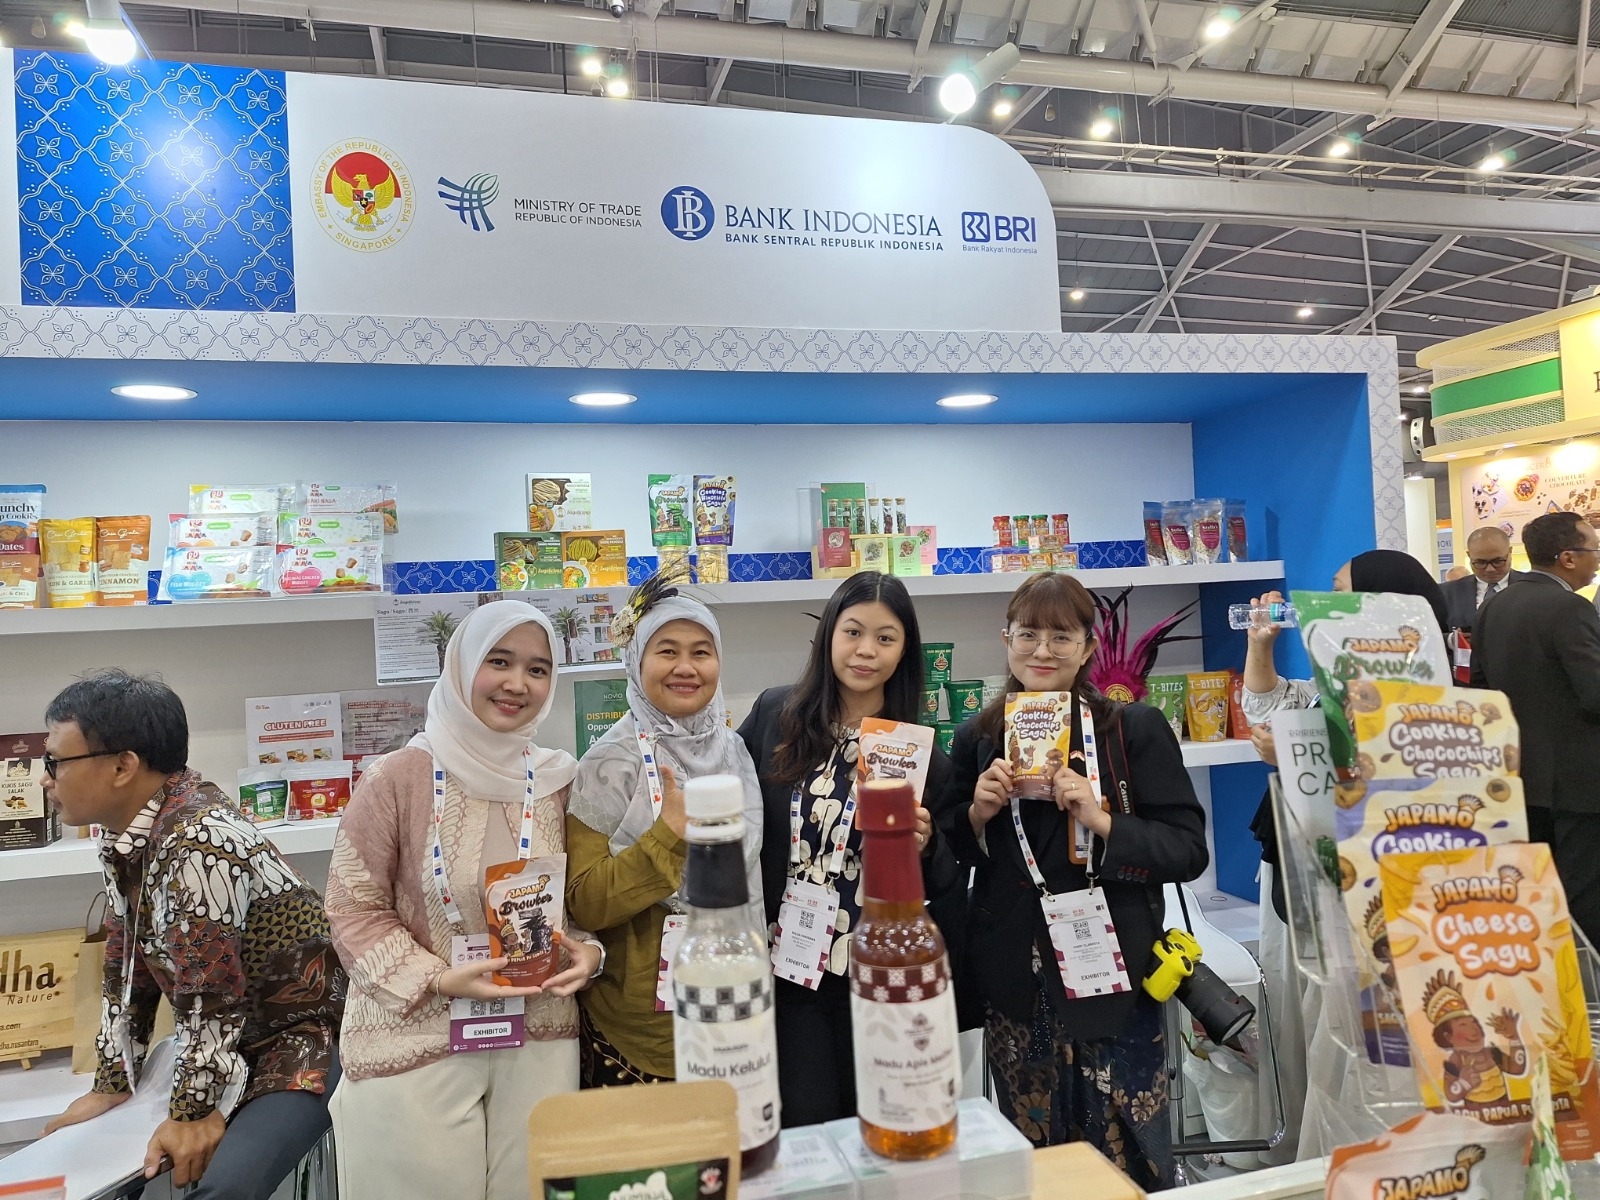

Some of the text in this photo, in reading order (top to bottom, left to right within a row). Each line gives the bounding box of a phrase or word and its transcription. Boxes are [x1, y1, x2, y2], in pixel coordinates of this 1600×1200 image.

[313, 141, 412, 222] EMBASSY OF THE REPUBLIC OF INDONESIA
[514, 198, 642, 217] MINISTRY OF TRADE
[515, 212, 642, 227] REPUBLIC OF INDONESIA
[724, 204, 943, 237] BANK INDONESIA
[995, 215, 1036, 242] BRI
[335, 232, 396, 250] SINGAPORE
[725, 233, 944, 252] BANK SENTRAL REPUBLIK INDONESIA
[962, 244, 1038, 254] Bank Rakyat Indonesia
[1549, 479, 1587, 489] CHOCOLATE
[1349, 637, 1418, 655] JAPAMO
[1150, 682, 1183, 693] T-BITES
[1189, 678, 1226, 689] T-BITES
[1022, 702, 1054, 712] JAPAMO
[1399, 702, 1474, 726] JAPAMO
[264, 718, 327, 731] GLUTEN FREE
[1014, 711, 1055, 723] Cookies
[1020, 728, 1047, 739] Sagu
[1390, 722, 1482, 747] Cookies
[877, 744, 913, 758] JAPAMO
[1118, 780, 1131, 814] Canon
[1385, 802, 1475, 833] JAPAMO
[510, 884, 546, 899] JAPAMO
[1432, 876, 1518, 912] JAPAMO
[1435, 912, 1536, 945] Cheese
[785, 957, 810, 970] EXHIBITOR
[1458, 943, 1533, 970] Sagu
[1081, 971, 1111, 981] EXHIBITOR
[7, 992, 53, 1006] Nature
[473, 1027, 508, 1036] EXHIBITOR
[687, 1061, 726, 1077] Madu
[1482, 1103, 1519, 1121] PAPUA
[1379, 1166, 1469, 1200] JAPAMO
